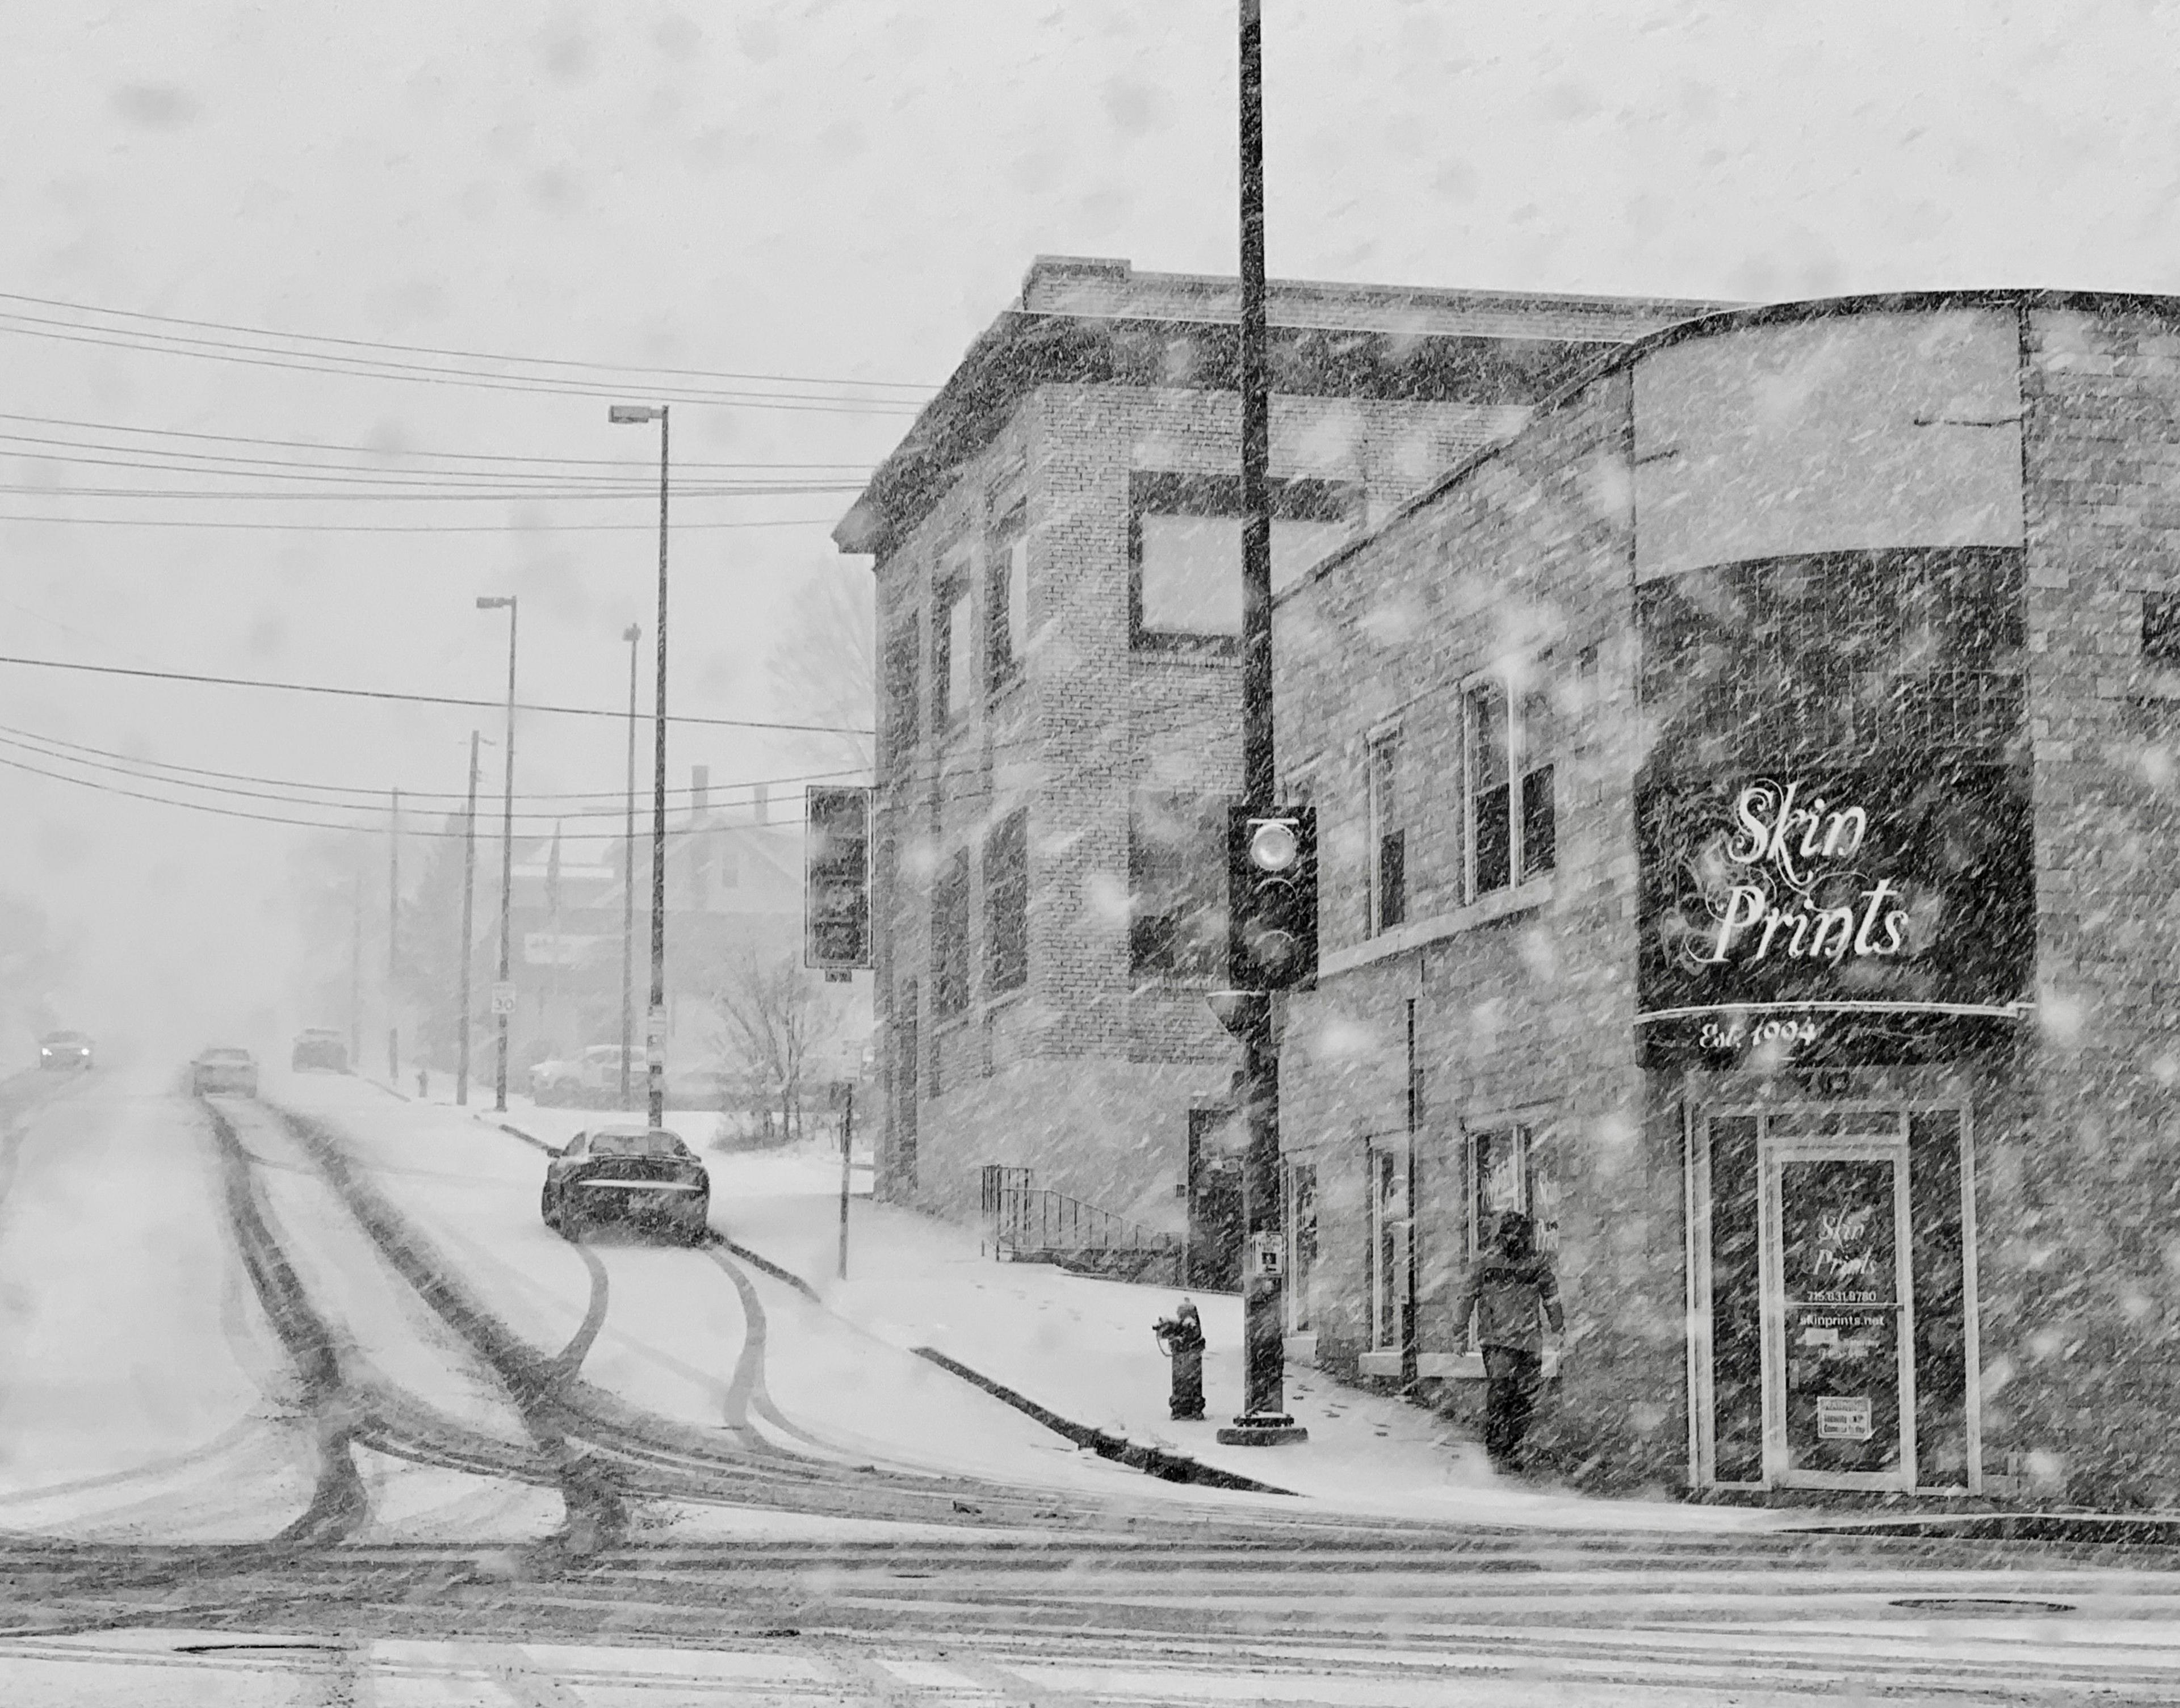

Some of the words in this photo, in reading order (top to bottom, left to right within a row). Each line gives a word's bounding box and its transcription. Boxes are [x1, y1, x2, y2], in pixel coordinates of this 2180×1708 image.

[1728, 778, 1867, 886] Skin
[1684, 879, 1909, 966] Prints
[1800, 1314, 1885, 1328] skinprints.net
